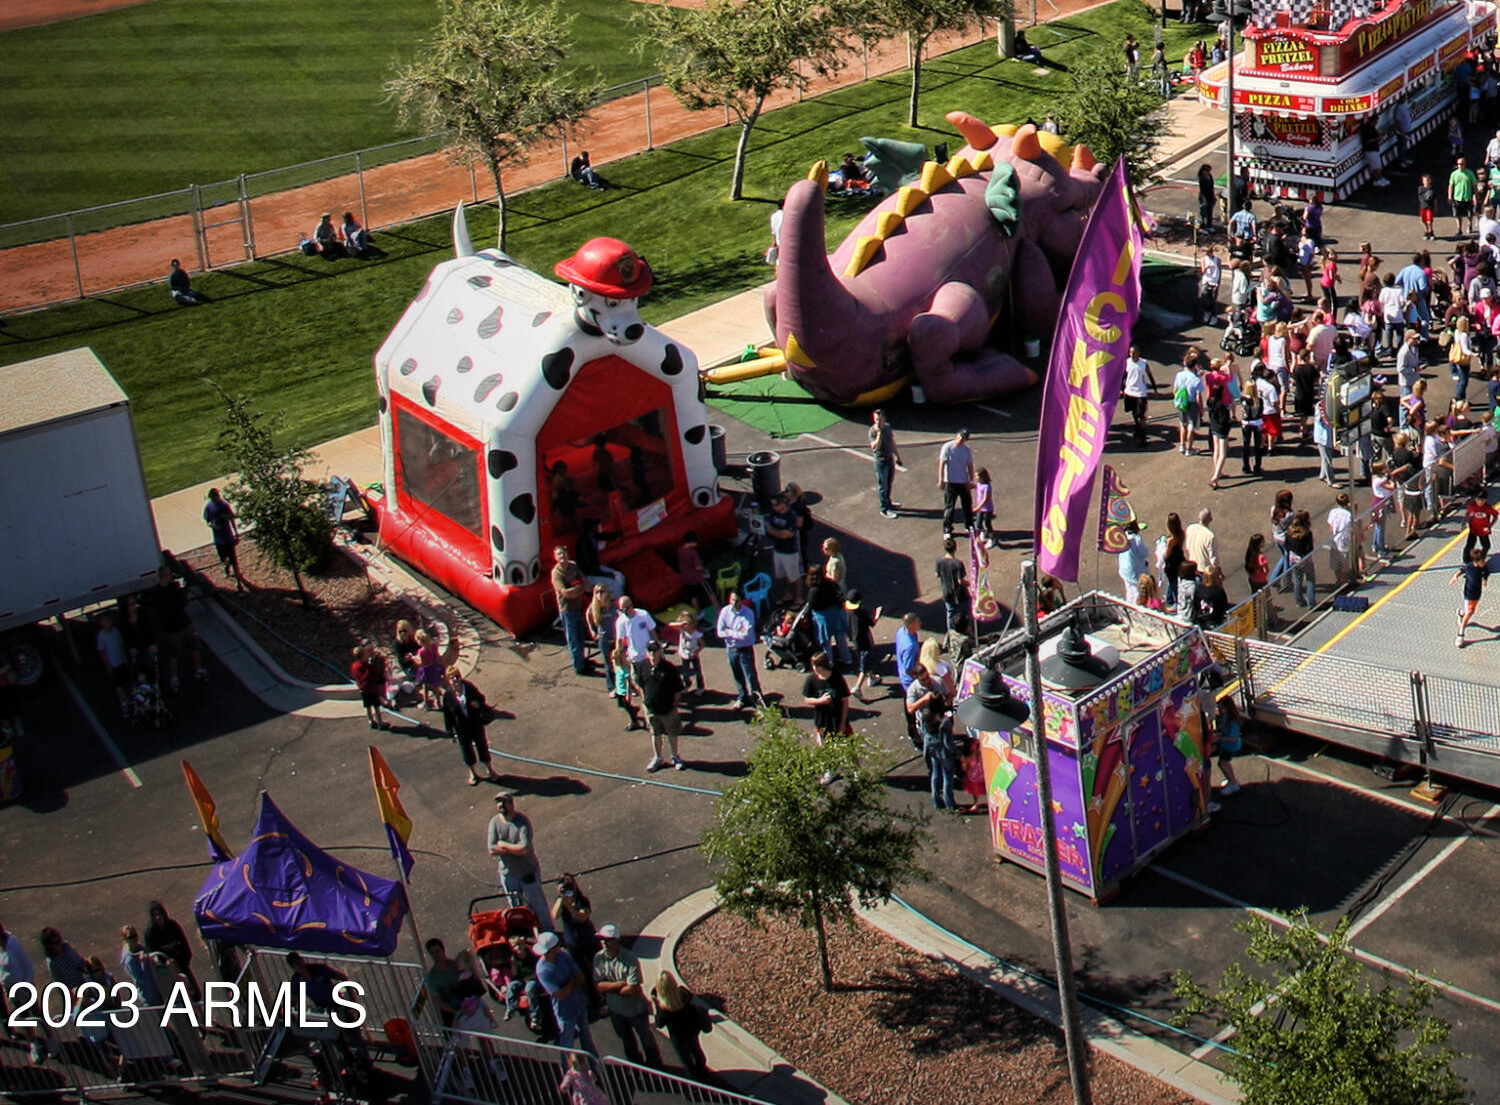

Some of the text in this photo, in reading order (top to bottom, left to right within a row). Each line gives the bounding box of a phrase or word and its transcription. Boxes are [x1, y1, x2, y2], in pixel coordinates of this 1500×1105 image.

[1260, 50, 1314, 65] PRETZEL
[1281, 62, 1315, 72] Bakery
[1248, 94, 1292, 107] PIZZA
[1329, 102, 1368, 113] DRINKS
[1273, 121, 1318, 135] PRETZEL
